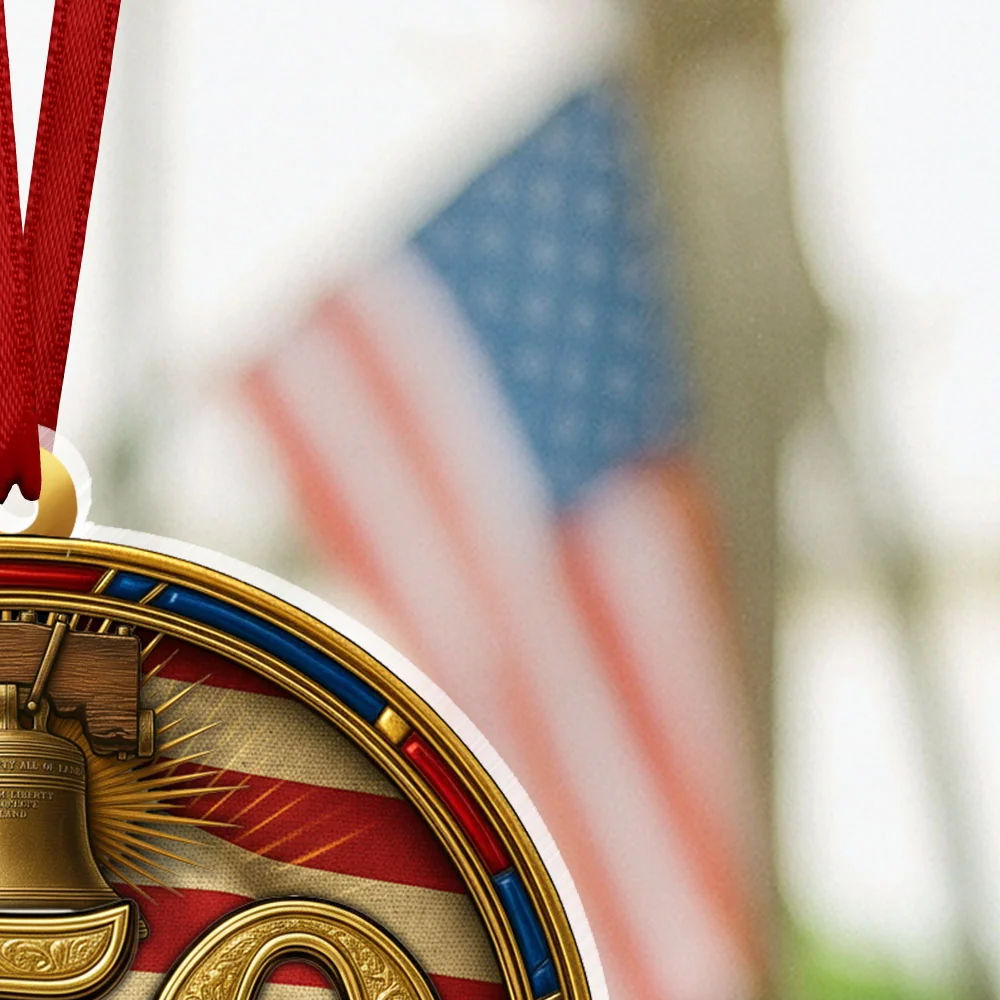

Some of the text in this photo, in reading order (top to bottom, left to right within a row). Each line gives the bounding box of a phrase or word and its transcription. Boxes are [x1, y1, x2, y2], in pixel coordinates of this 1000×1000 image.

[19, 760, 38, 770] ALL
[11, 791, 54, 800] LIBERTY
[0, 810, 27, 819] LAND
